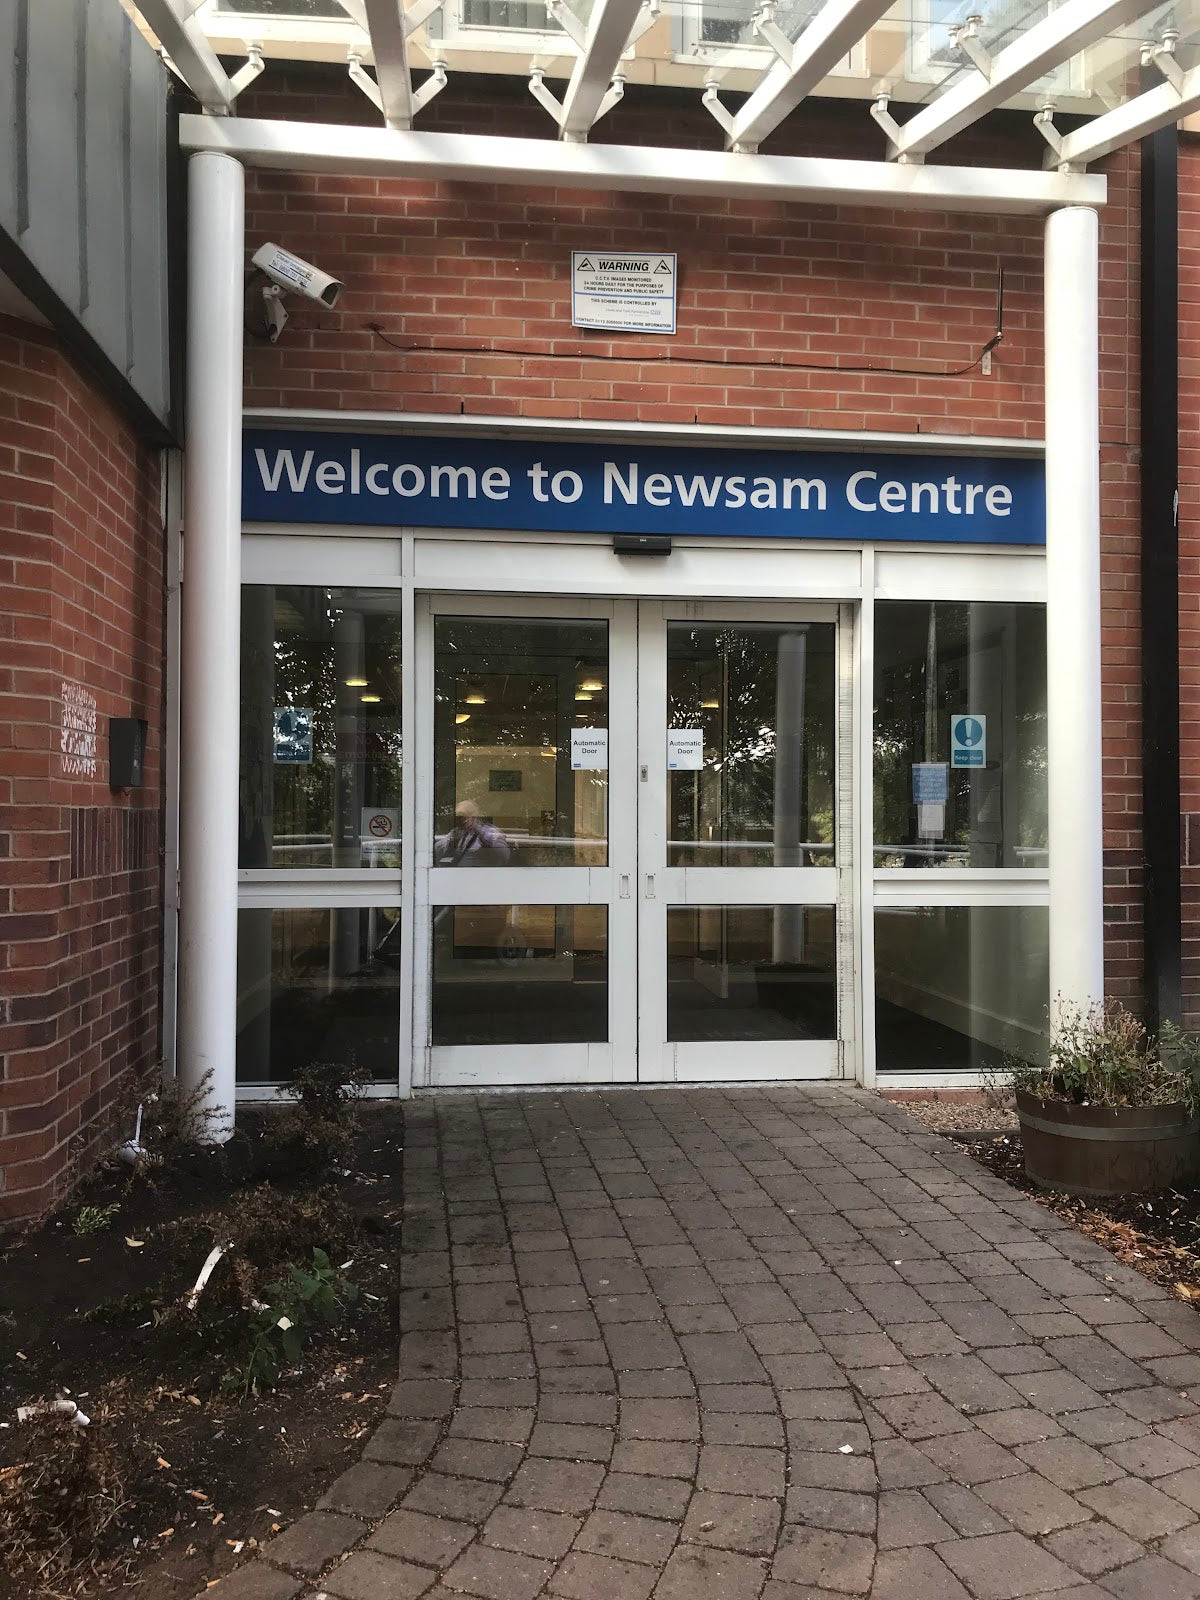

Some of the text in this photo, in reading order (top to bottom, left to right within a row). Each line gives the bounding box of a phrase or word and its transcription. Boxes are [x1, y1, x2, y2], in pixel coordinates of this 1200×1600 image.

[599, 261, 649, 272] WARNING
[255, 448, 1013, 516] Welcome to Newsam Centre
